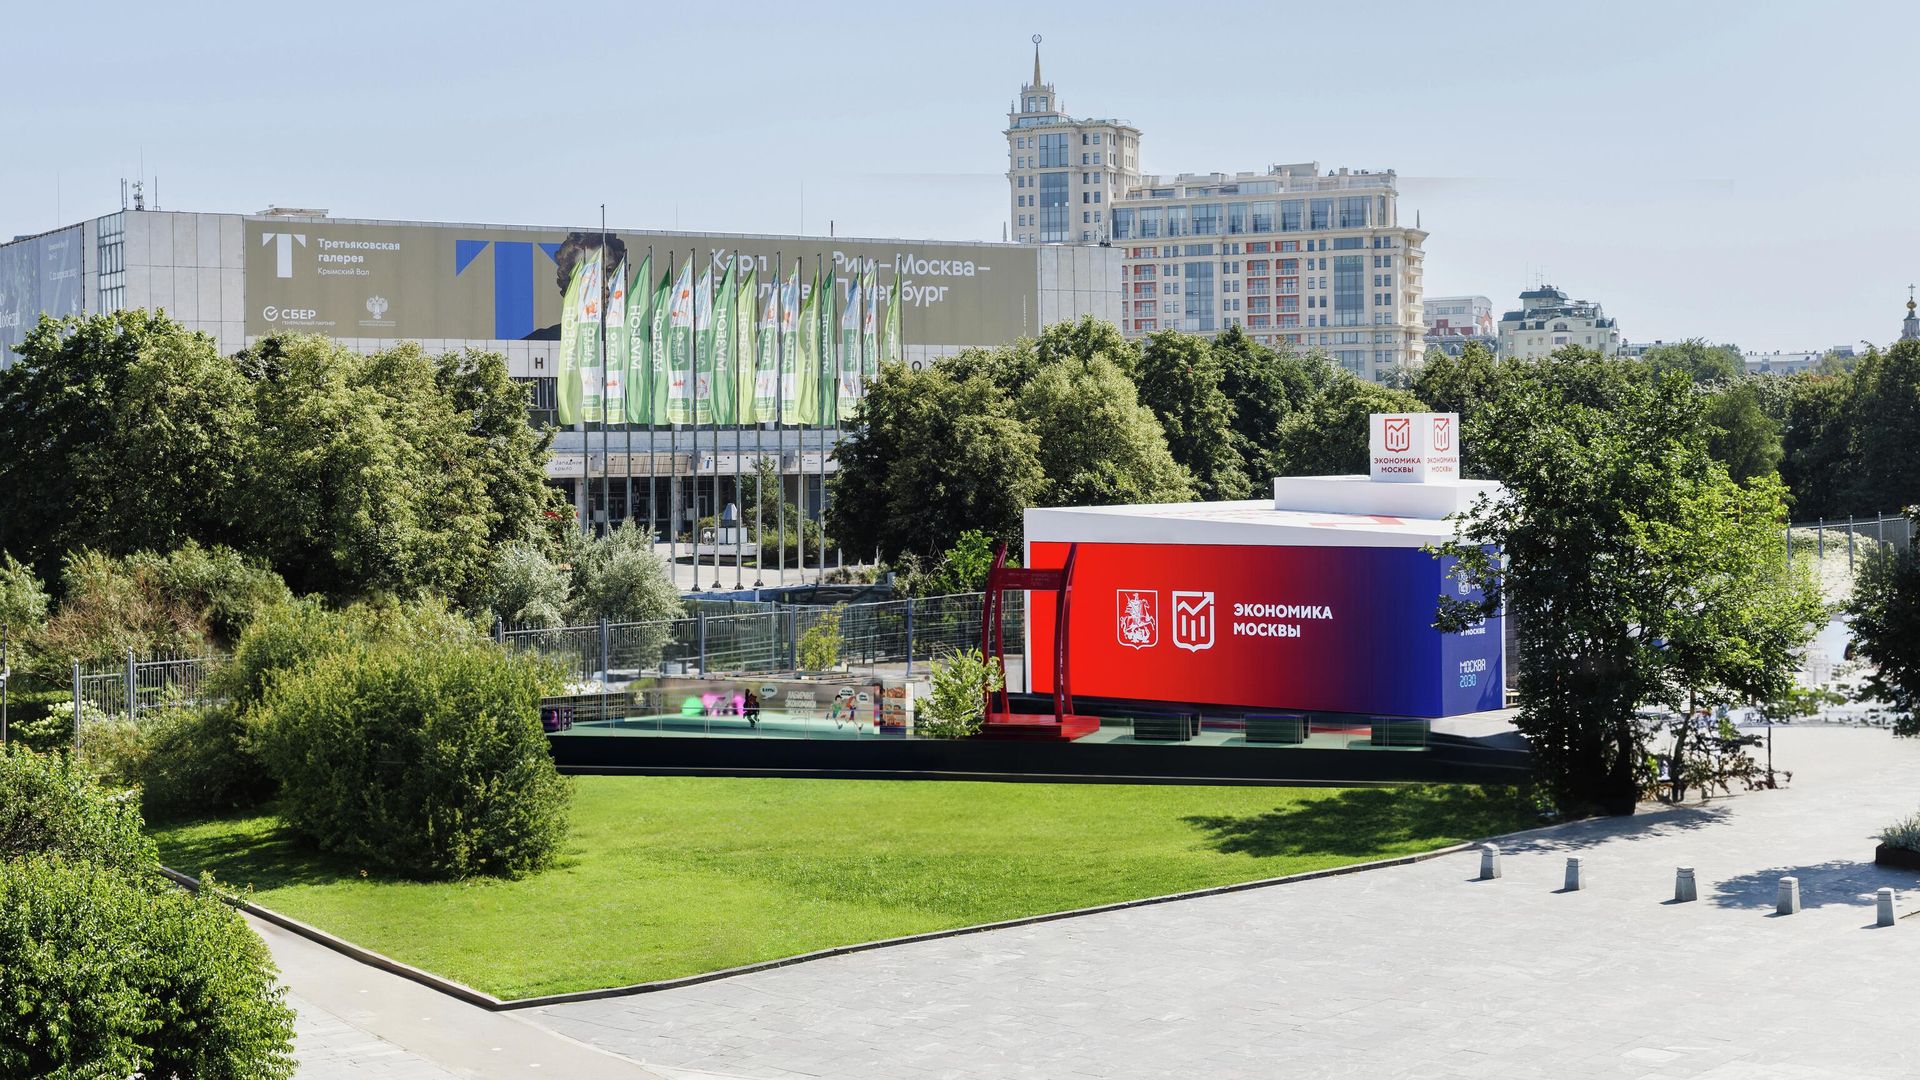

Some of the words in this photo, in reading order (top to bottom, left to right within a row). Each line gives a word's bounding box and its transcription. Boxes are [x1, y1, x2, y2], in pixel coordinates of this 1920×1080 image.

[317, 238, 400, 250] Третьяковская
[318, 253, 364, 264] галерея
[317, 267, 354, 276] Крымский
[356, 268, 370, 276] Вал
[281, 308, 317, 320] СБЕР
[535, 357, 544, 369] Н
[1233, 603, 1333, 620] ЭКОНОМИКА
[1233, 622, 1301, 638] МОСКВЫ
[1459, 658, 1486, 673] МОСКВА
[1459, 674, 1477, 688] 2030
